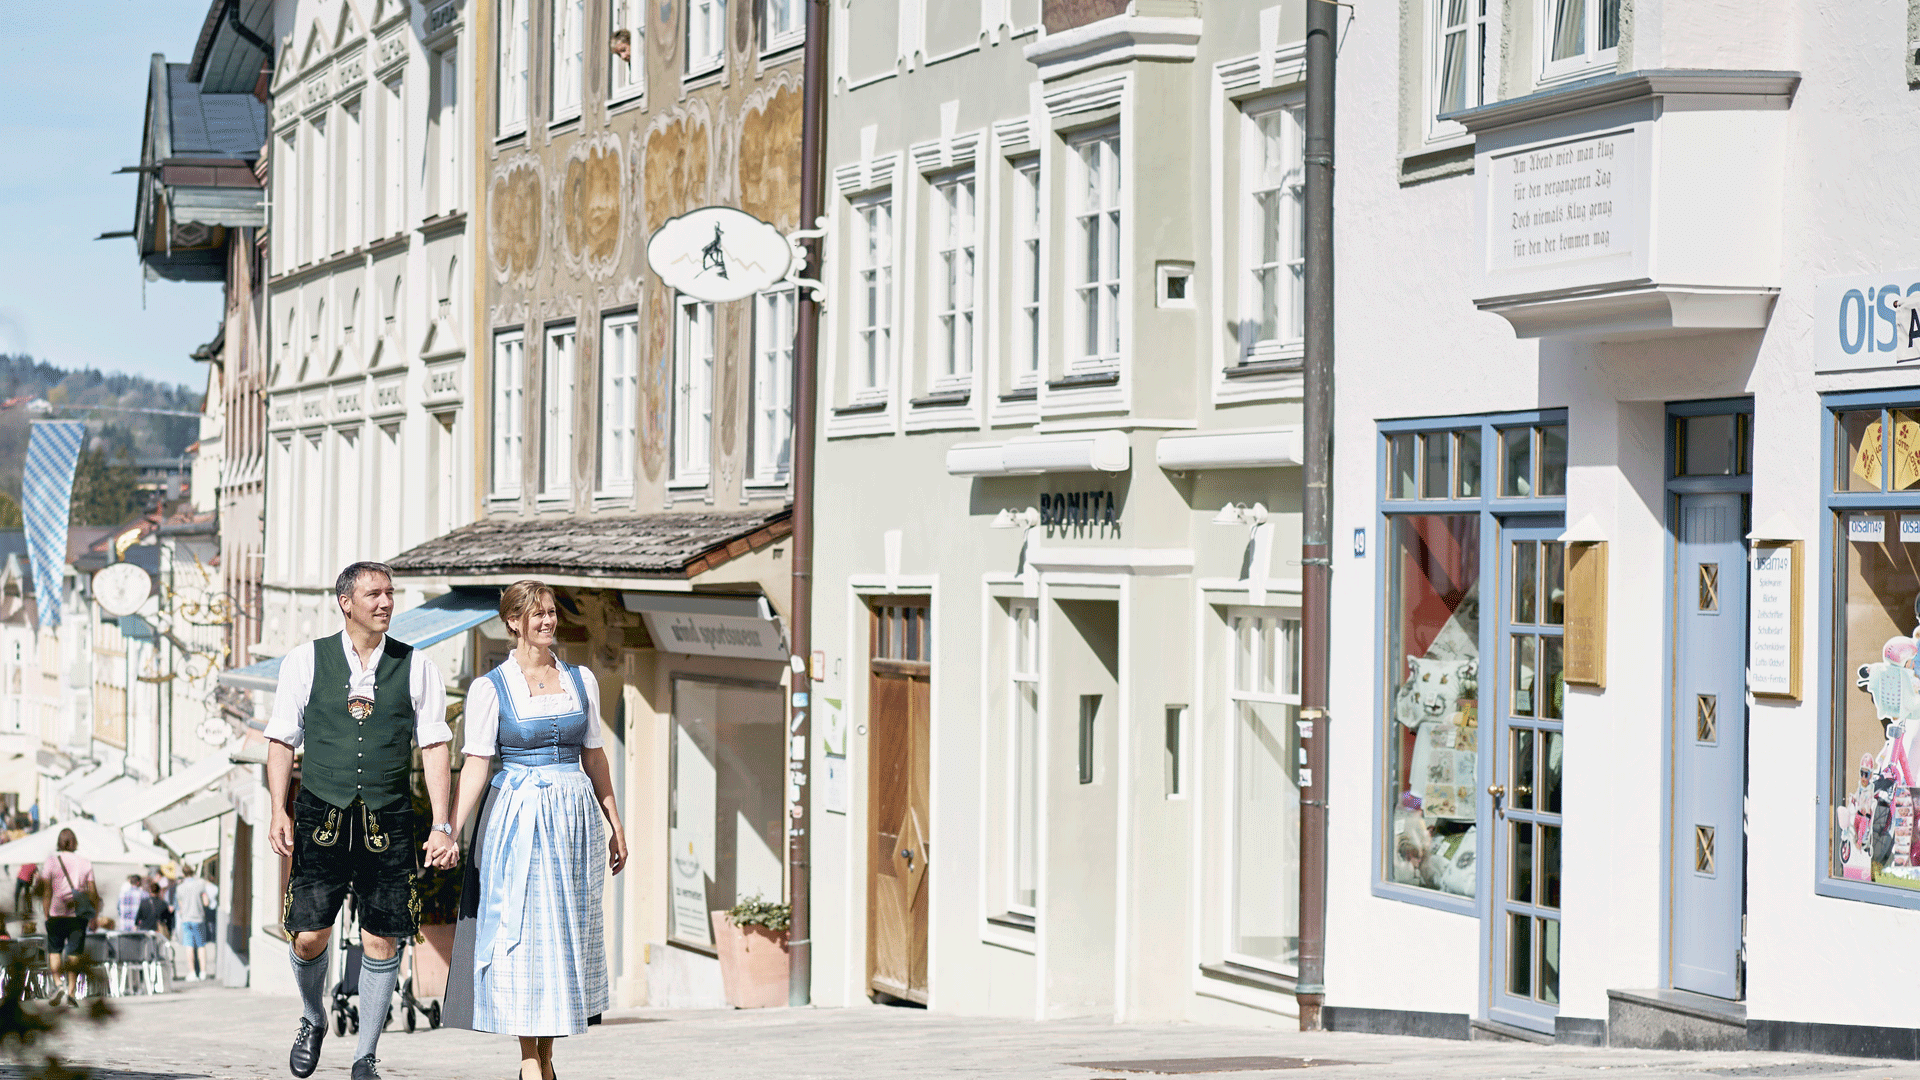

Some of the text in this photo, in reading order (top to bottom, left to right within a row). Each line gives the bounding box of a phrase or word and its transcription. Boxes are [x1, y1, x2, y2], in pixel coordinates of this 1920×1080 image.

[1513, 140, 1614, 174] Am Abend wird man klug
[1514, 168, 1611, 201] für den vergangenen Tag
[1512, 210, 1530, 230] Doch
[1533, 205, 1563, 226] niemals
[1589, 200, 1612, 221] genug
[1514, 230, 1610, 258] für den der kommen mag
[1865, 454, 1875, 479] LOTTO
[1908, 451, 1919, 477] LOTTO
[1040, 491, 1116, 526] BONITA
[1355, 532, 1365, 553] 49
